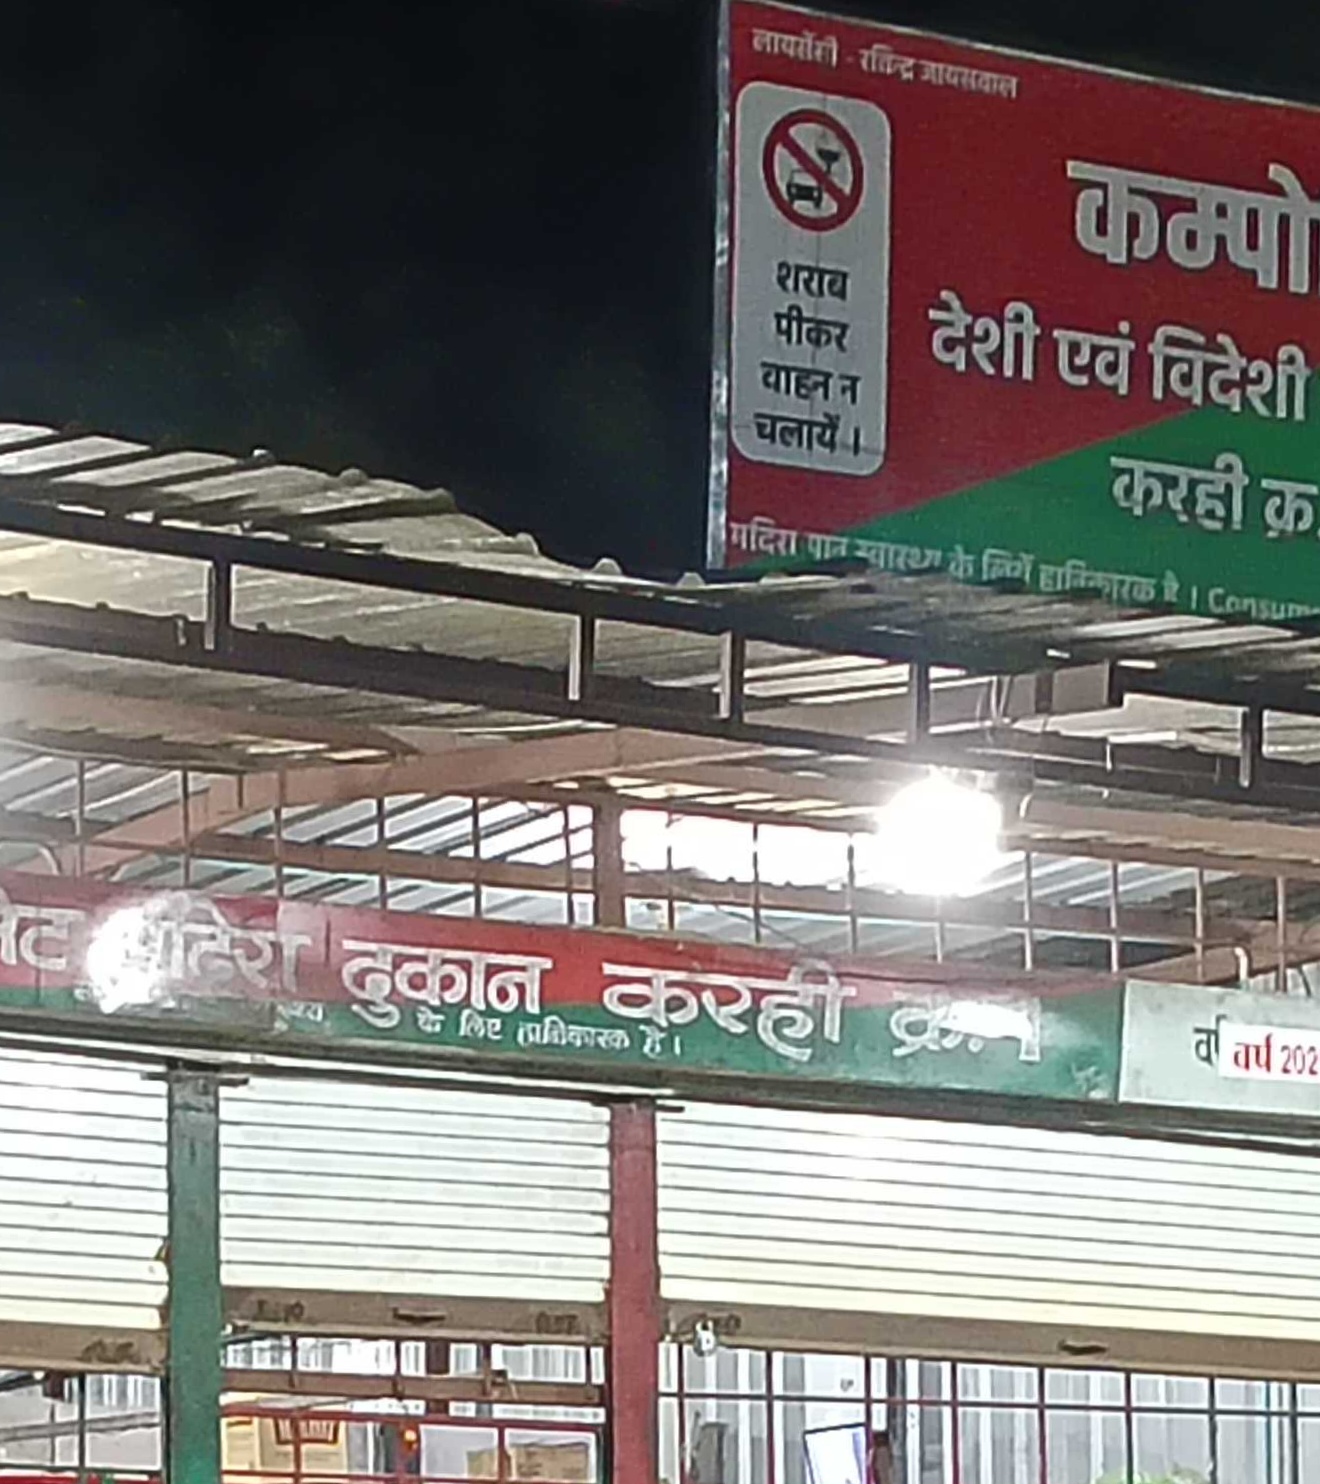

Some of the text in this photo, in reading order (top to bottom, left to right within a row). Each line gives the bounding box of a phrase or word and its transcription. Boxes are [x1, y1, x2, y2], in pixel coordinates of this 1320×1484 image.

[777, 261, 849, 301] शराब
[774, 304, 849, 352] पीकर
[928, 290, 1040, 381] देशी
[1053, 320, 1134, 397] एवं
[1148, 324, 1313, 422] विदेशी
[760, 361, 861, 405] वाहन न
[1111, 452, 1248, 531] करही
[342, 939, 553, 1030] दुकान
[601, 957, 856, 1062] करही
[1233, 1032, 1273, 1073] वर्ष
